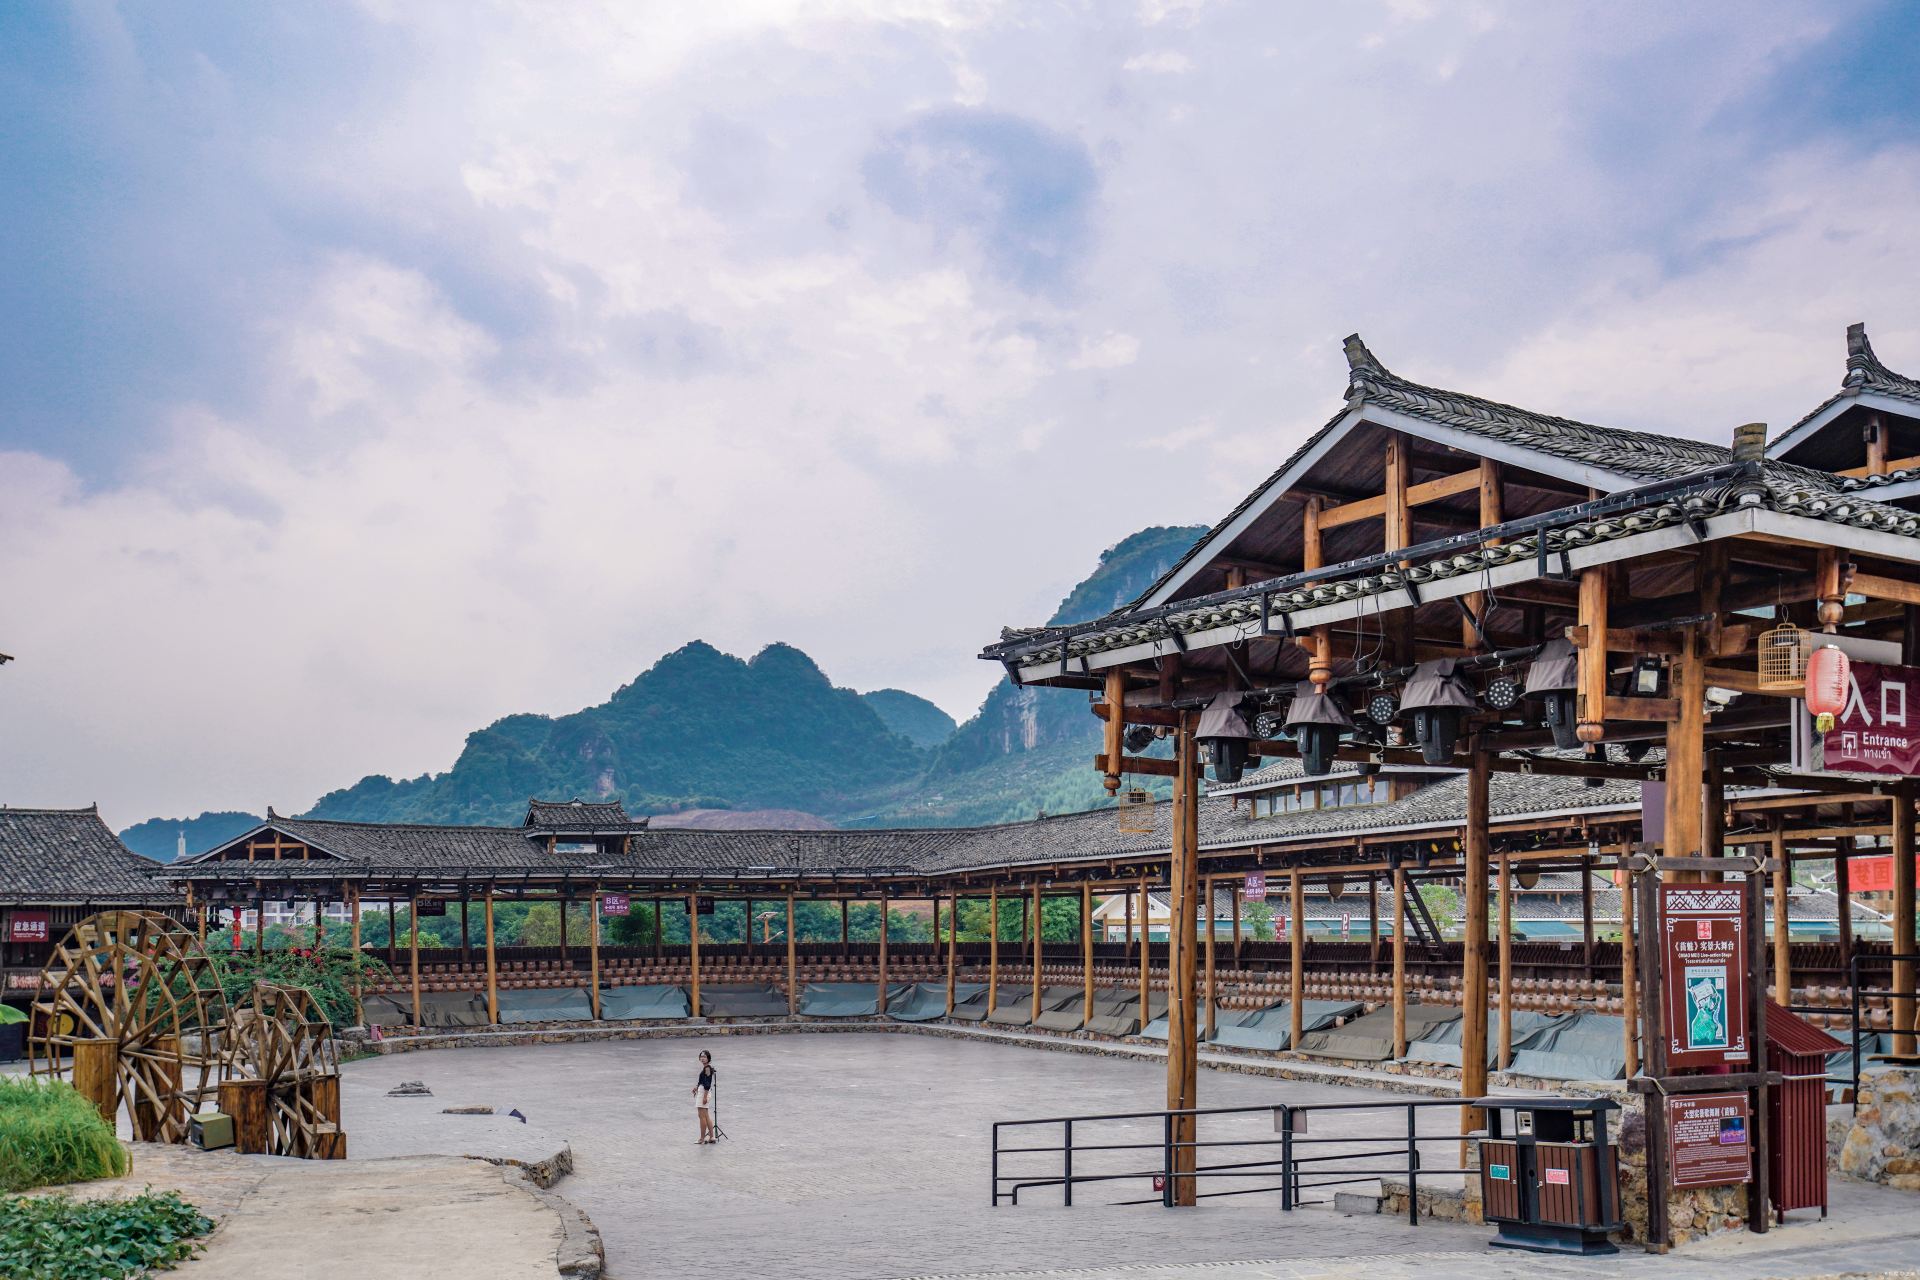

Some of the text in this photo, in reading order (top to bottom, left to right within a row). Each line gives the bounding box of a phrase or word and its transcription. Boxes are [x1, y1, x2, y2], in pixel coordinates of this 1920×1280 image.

[1840, 671, 1907, 727] 入口
[1863, 731, 1908, 748] Entrance
[14, 920, 46, 931] 应急通道
